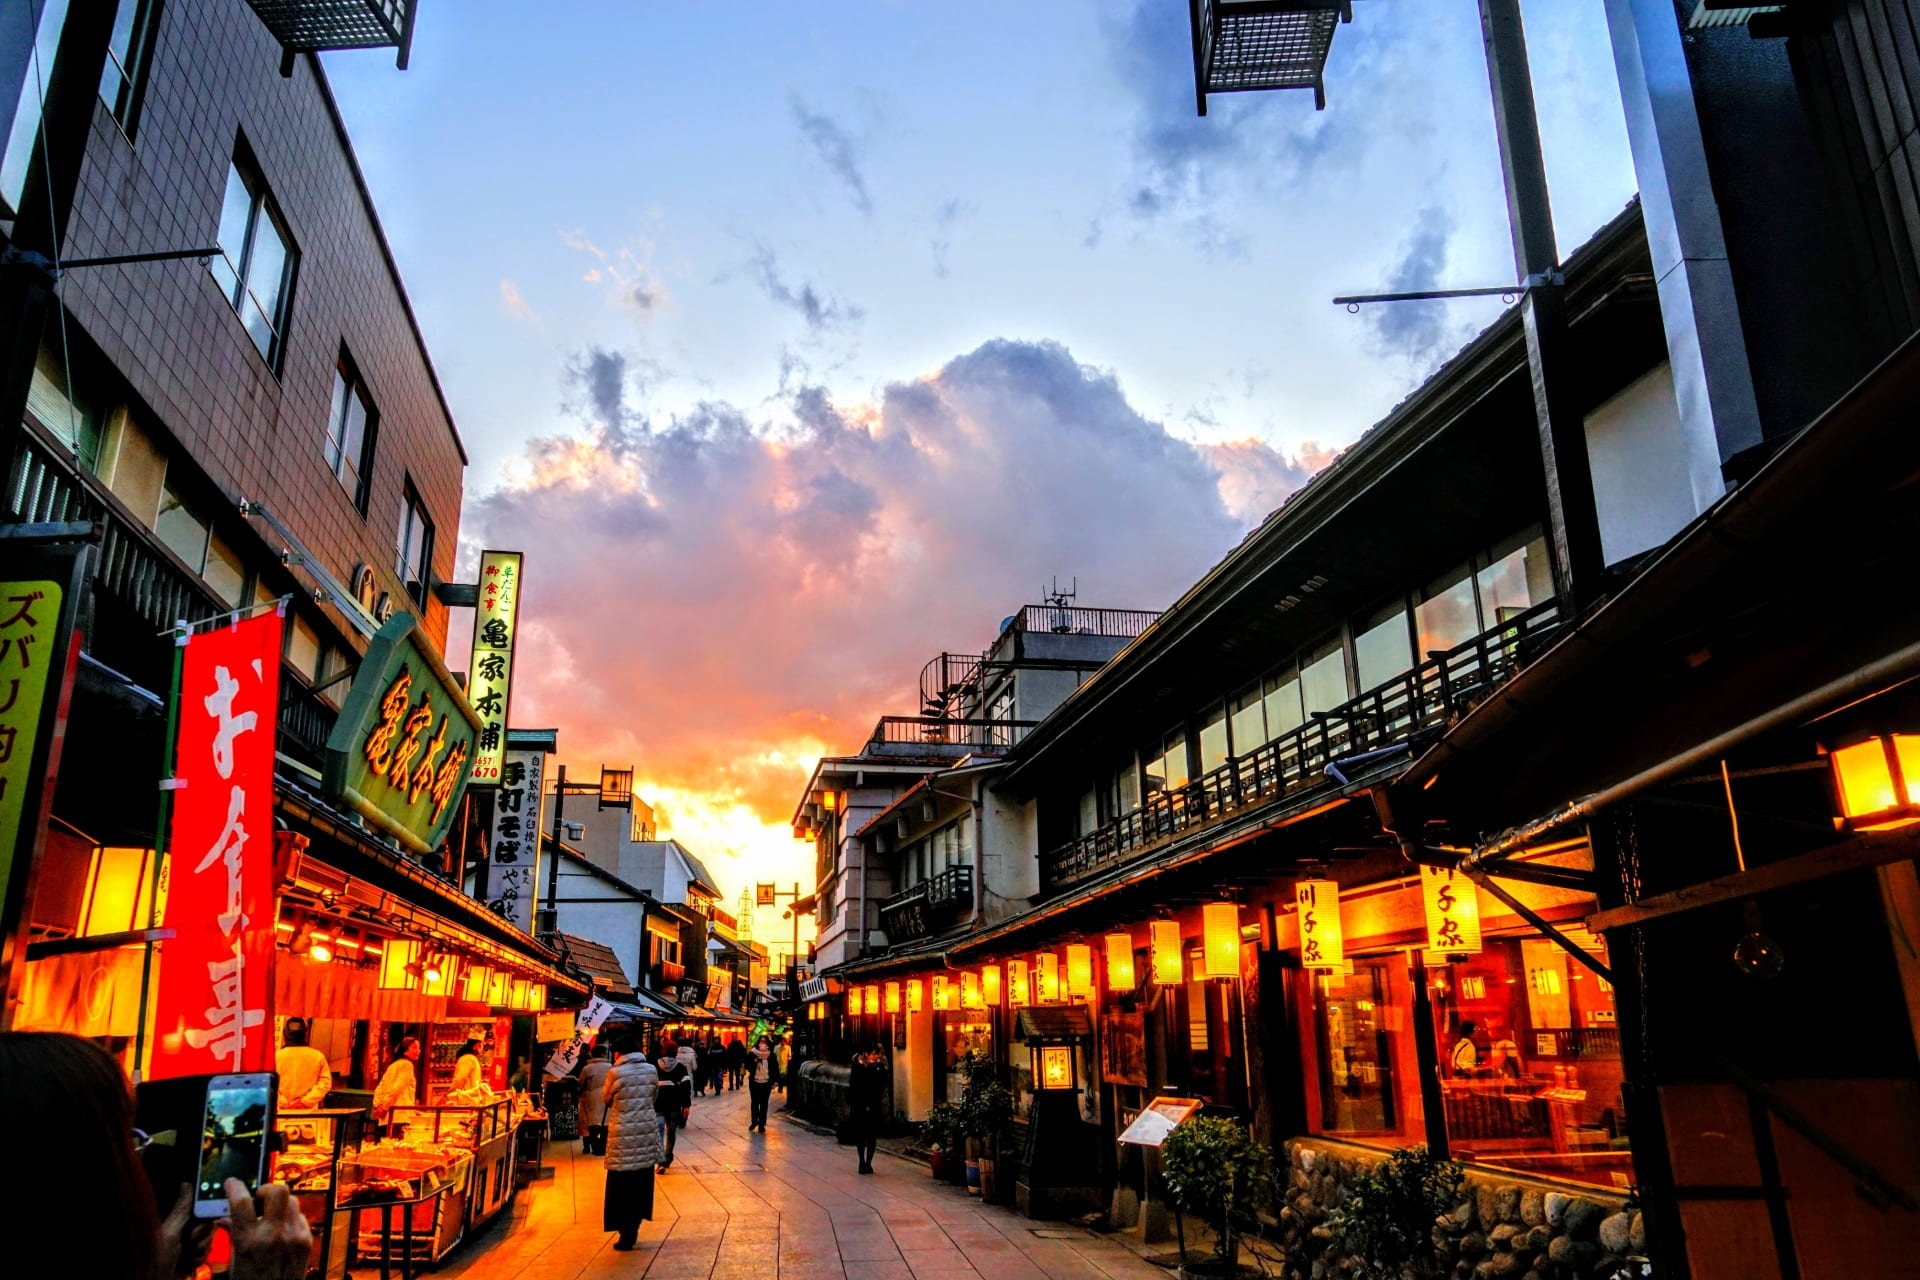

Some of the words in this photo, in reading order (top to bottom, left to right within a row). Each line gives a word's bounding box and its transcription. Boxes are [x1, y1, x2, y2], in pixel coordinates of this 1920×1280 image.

[484, 564, 500, 612] 御食事
[500, 565, 514, 612] 草だんご
